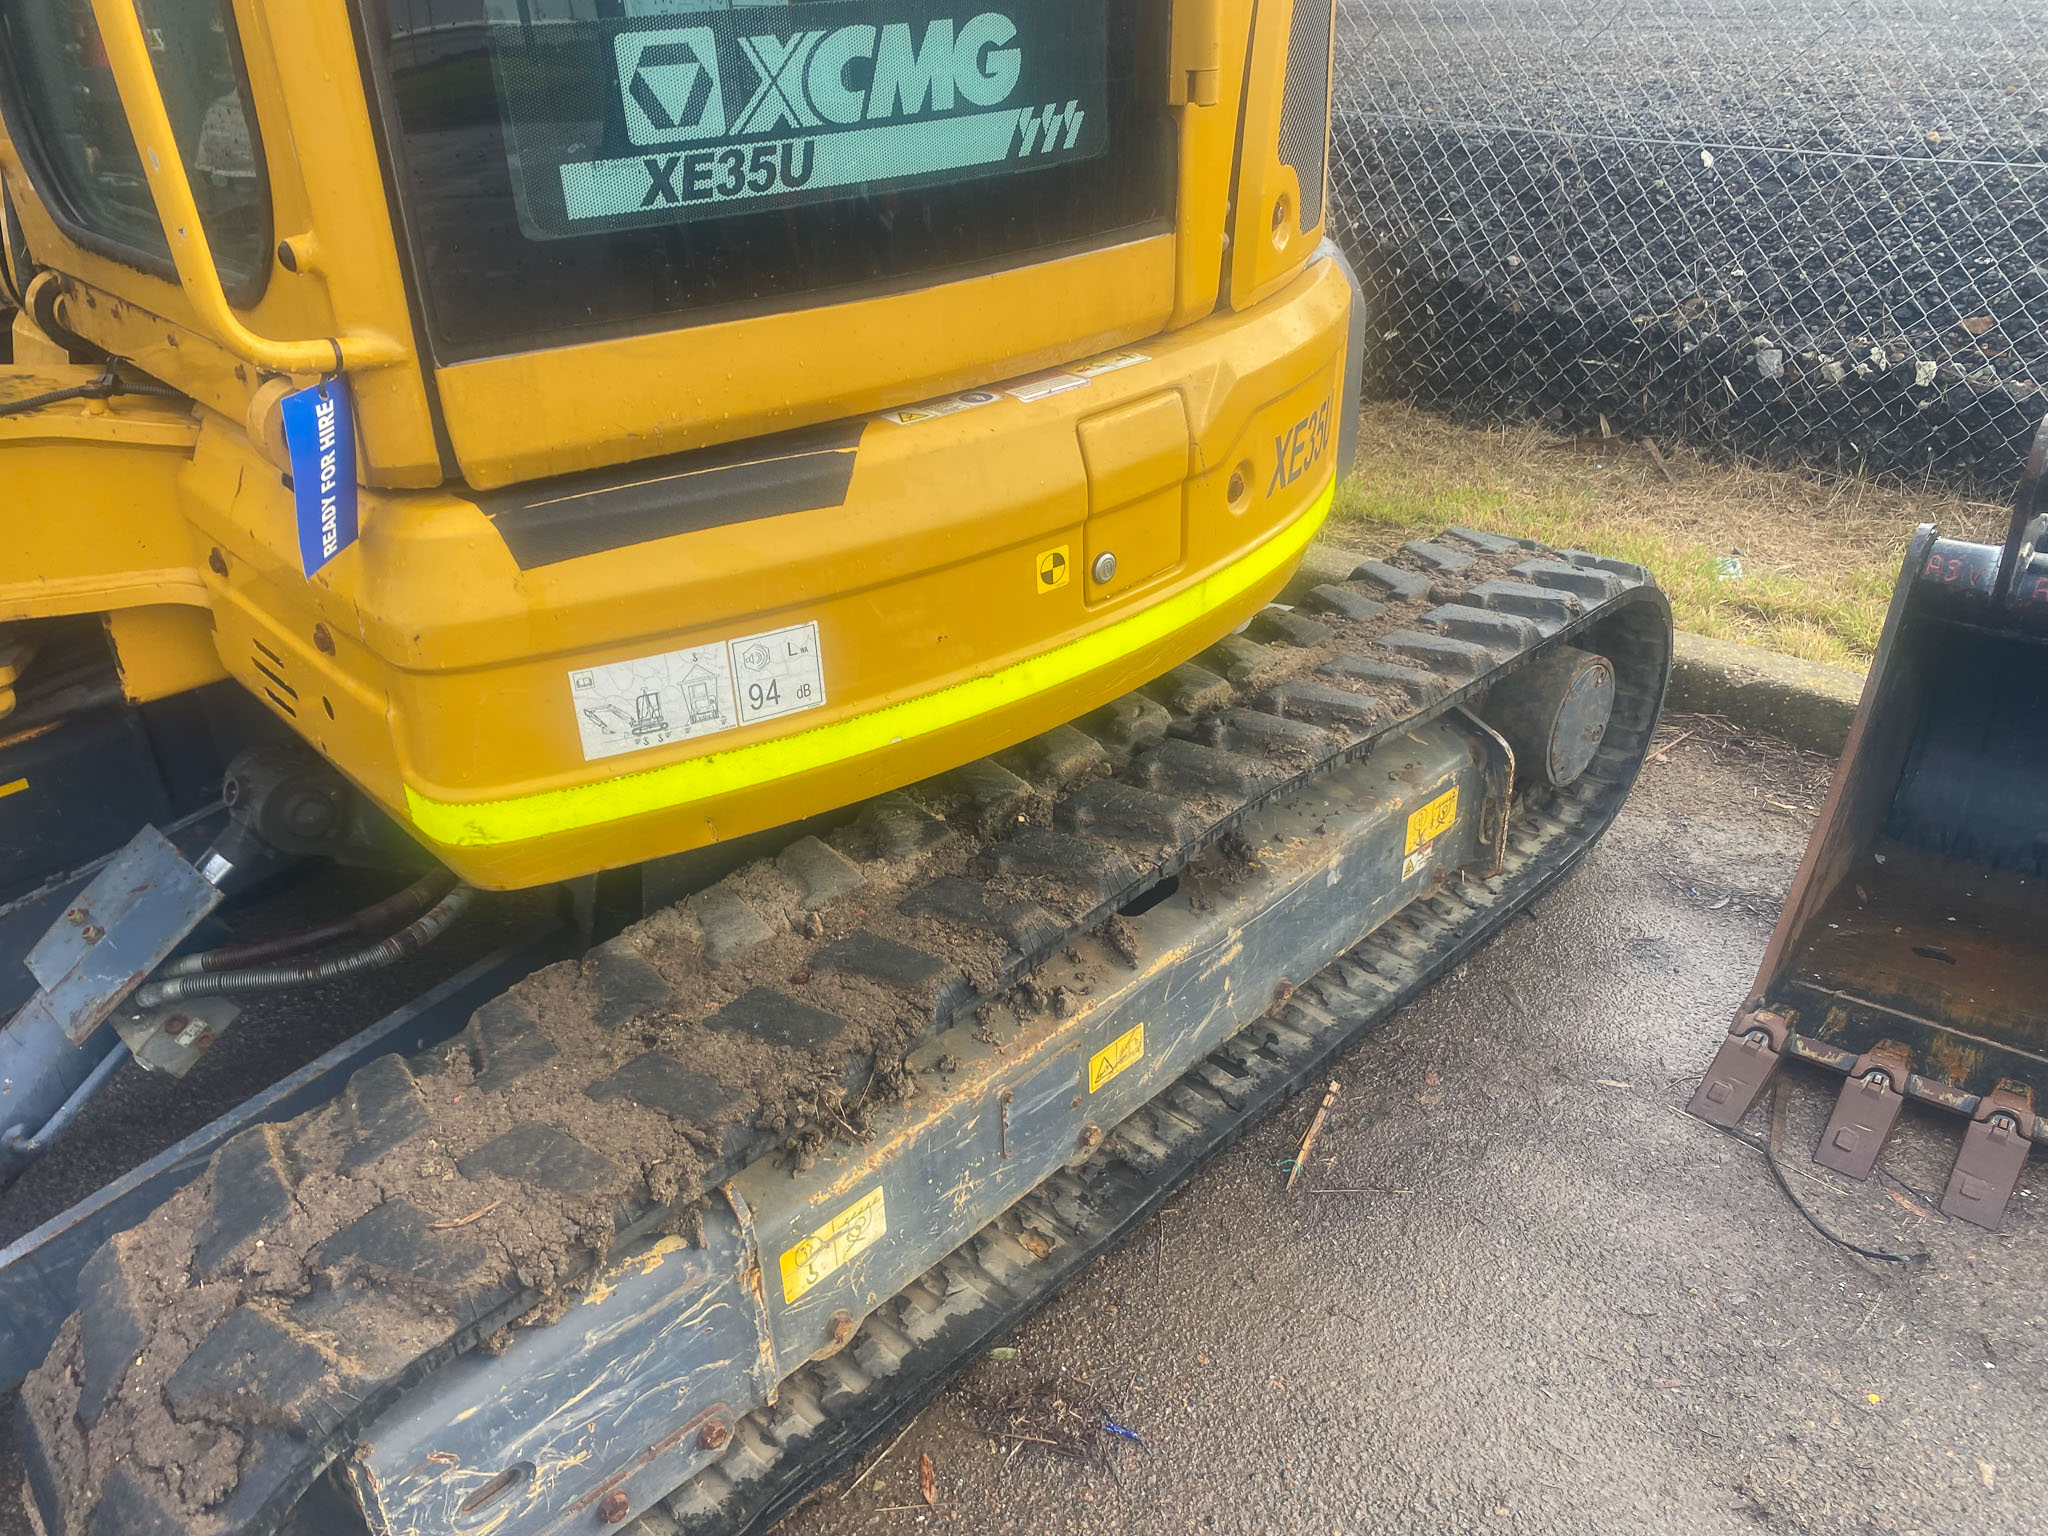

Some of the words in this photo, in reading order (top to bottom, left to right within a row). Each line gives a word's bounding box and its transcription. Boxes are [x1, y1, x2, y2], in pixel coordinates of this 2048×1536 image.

[729, 12, 1022, 135] XCMG
[641, 138, 816, 210] XE35U
[315, 399, 336, 451] HIRE
[320, 450, 336, 494] FOR
[321, 495, 338, 559] READY
[748, 678, 780, 710] 94
[796, 683, 811, 699] dB
